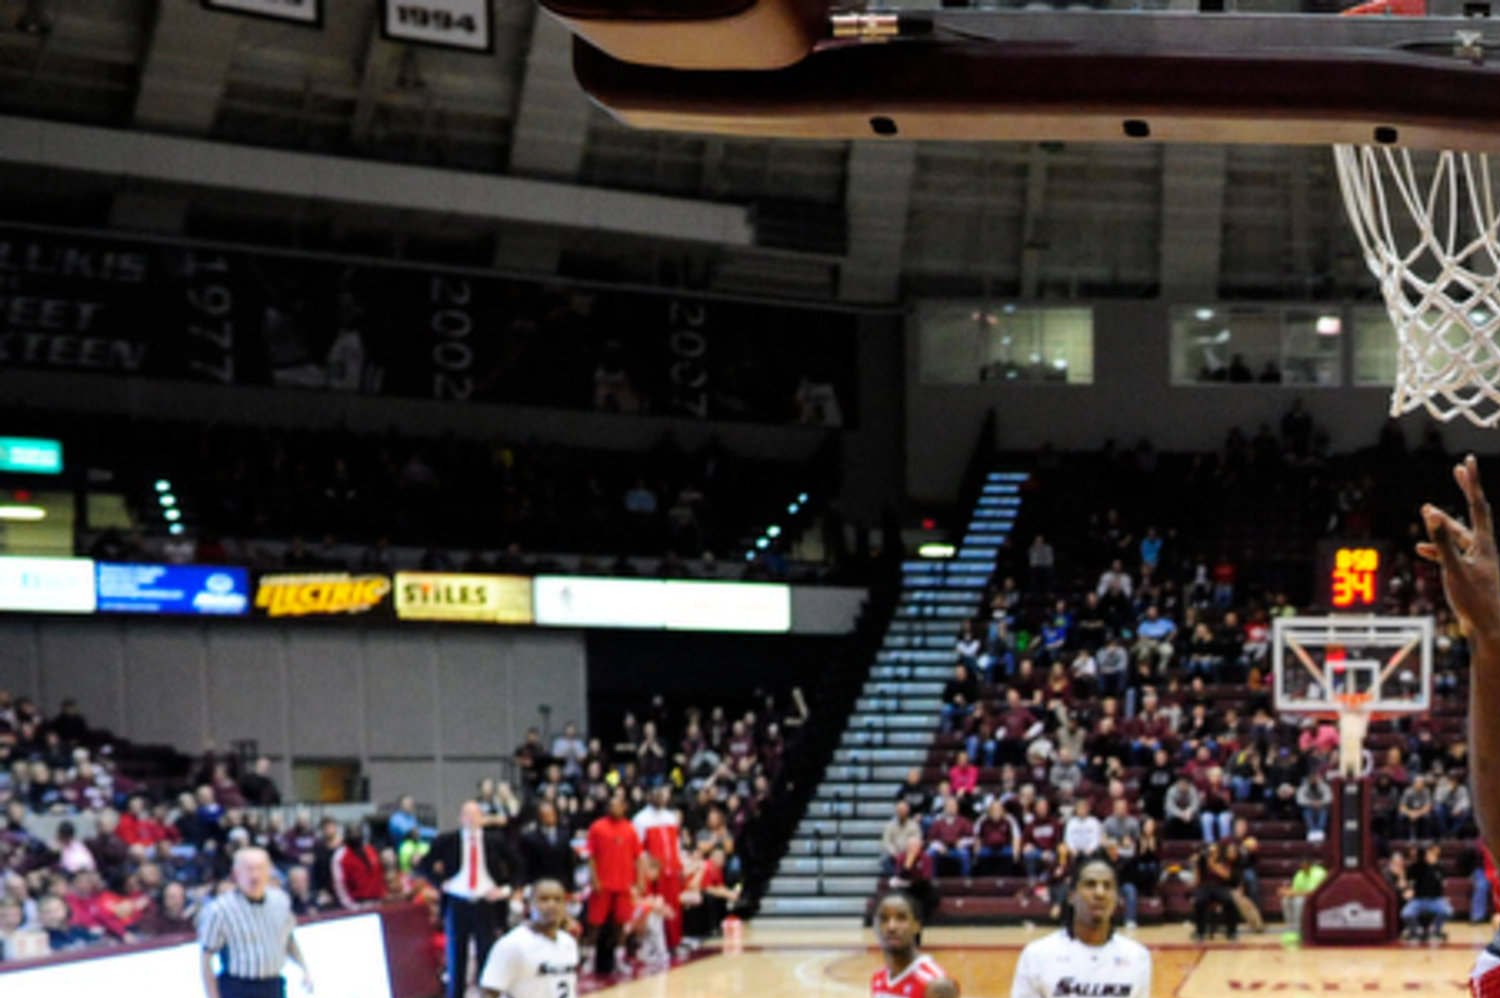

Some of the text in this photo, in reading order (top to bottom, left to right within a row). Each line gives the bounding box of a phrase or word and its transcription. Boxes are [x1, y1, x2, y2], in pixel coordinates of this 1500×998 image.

[397, 6, 476, 32] 1994
[429, 276, 475, 401] 2002
[1332, 570, 1374, 606] 34
